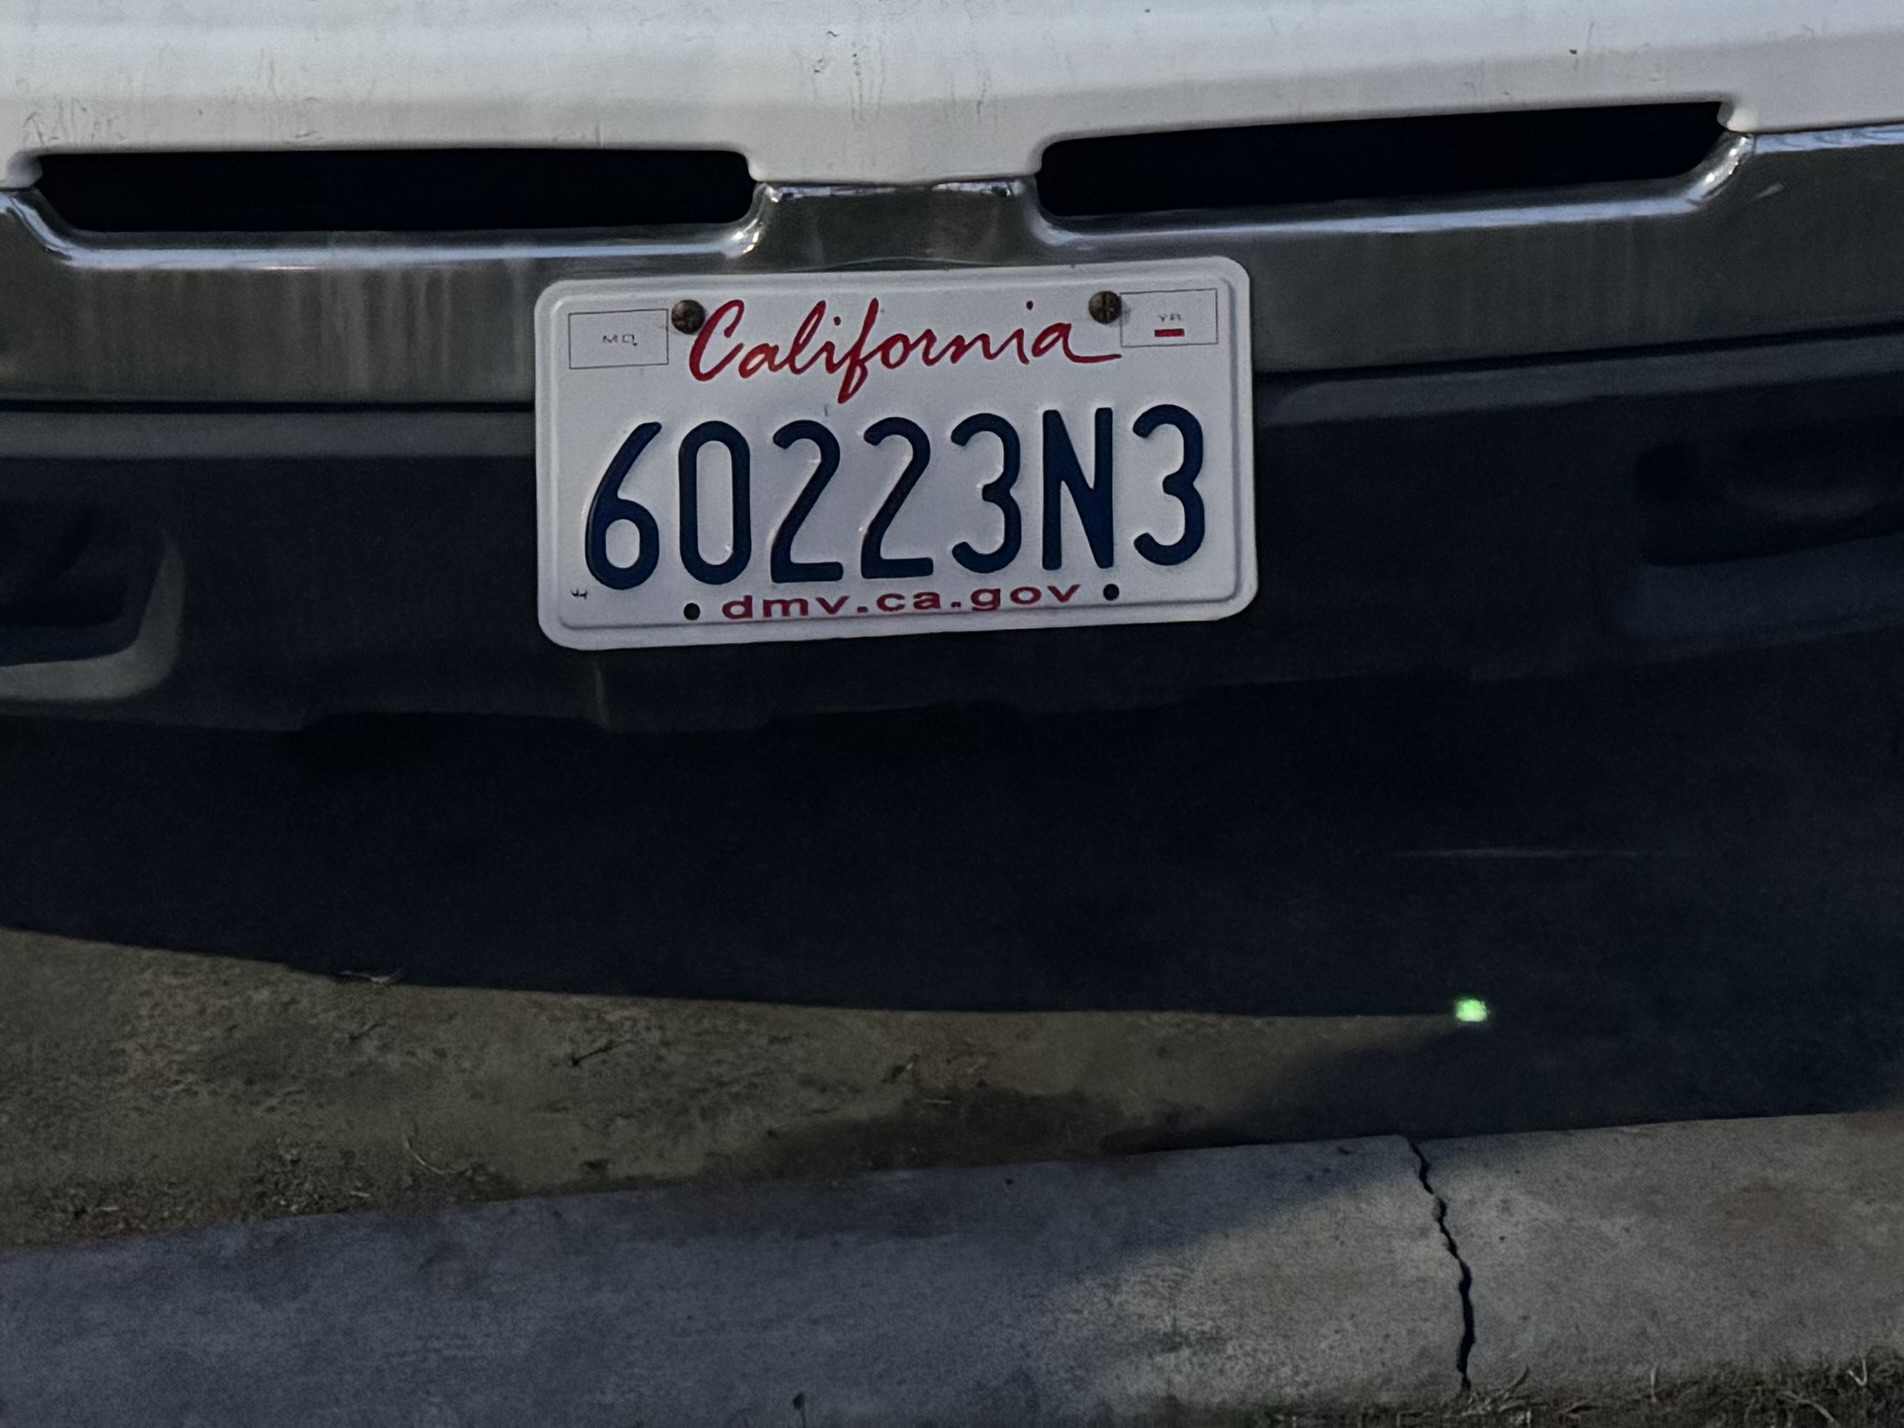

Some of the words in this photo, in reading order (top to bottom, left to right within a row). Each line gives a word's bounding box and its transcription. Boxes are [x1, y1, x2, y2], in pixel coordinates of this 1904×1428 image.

[688, 299, 1122, 404] California
[584, 403, 1206, 591] 60223N3
[721, 582, 1082, 620] dmv.ca.gov
